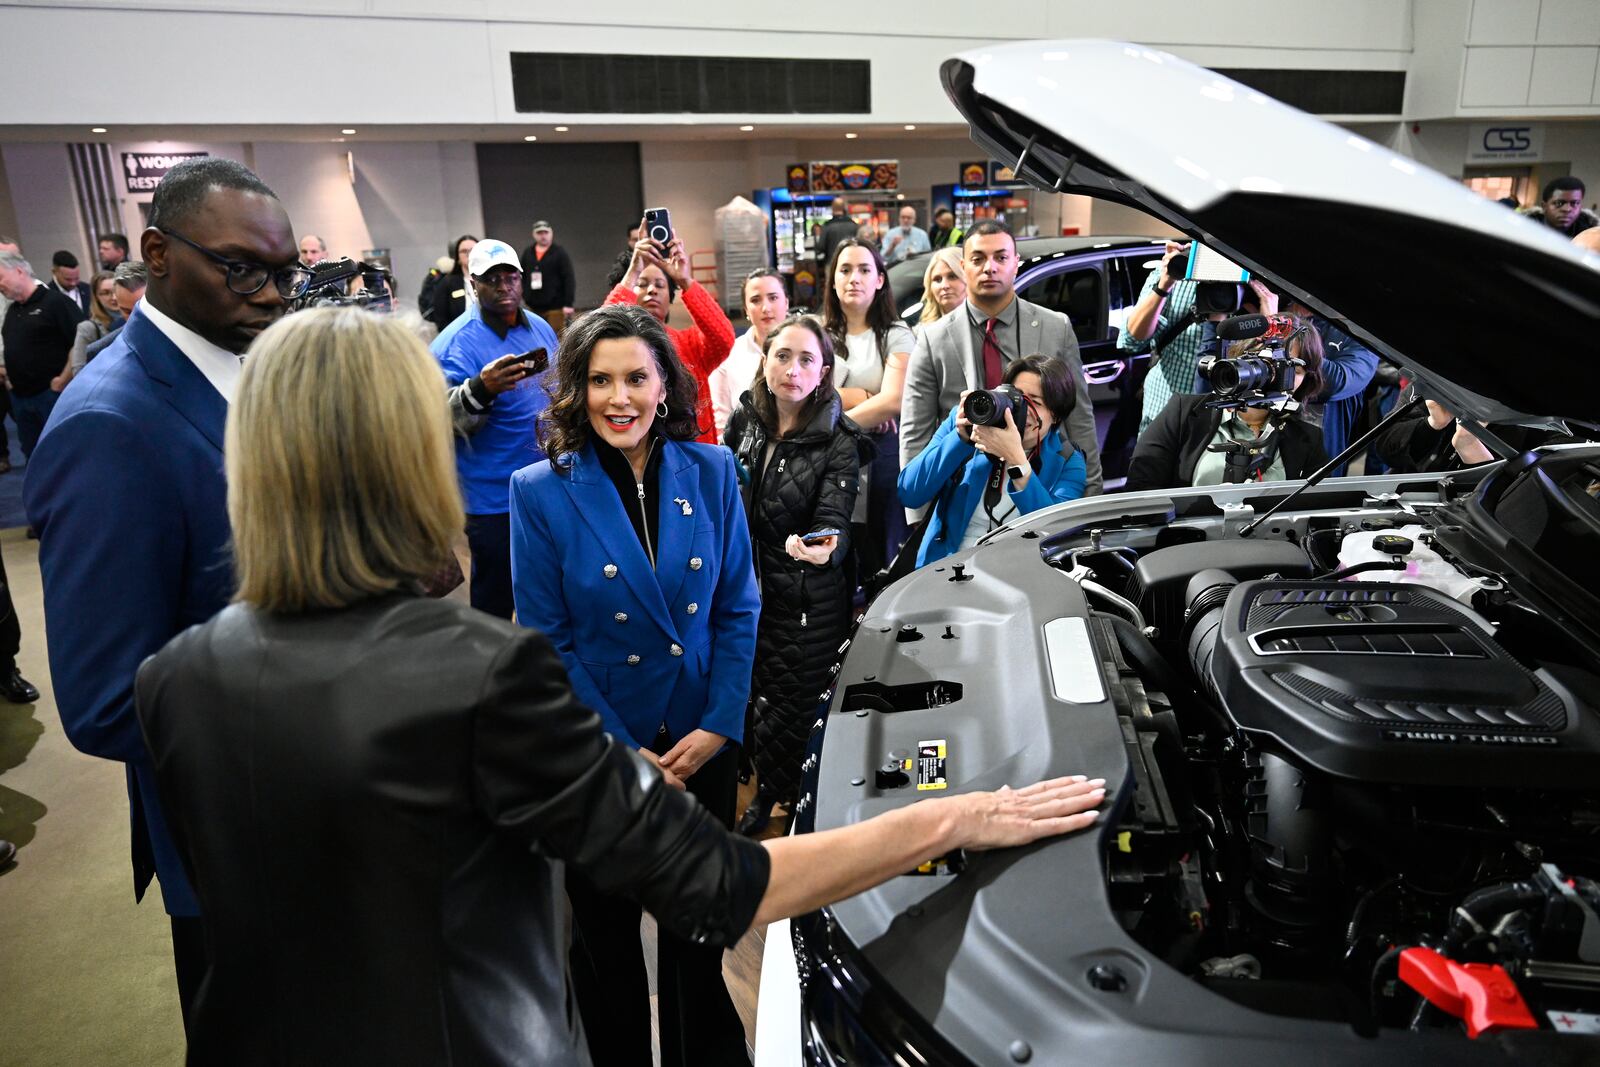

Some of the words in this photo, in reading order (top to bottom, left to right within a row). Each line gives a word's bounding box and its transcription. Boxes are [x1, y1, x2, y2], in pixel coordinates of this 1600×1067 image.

[1484, 128, 1530, 151] CSS
[1388, 731, 1456, 741] TWIN
[1462, 734, 1558, 744] TURBO
